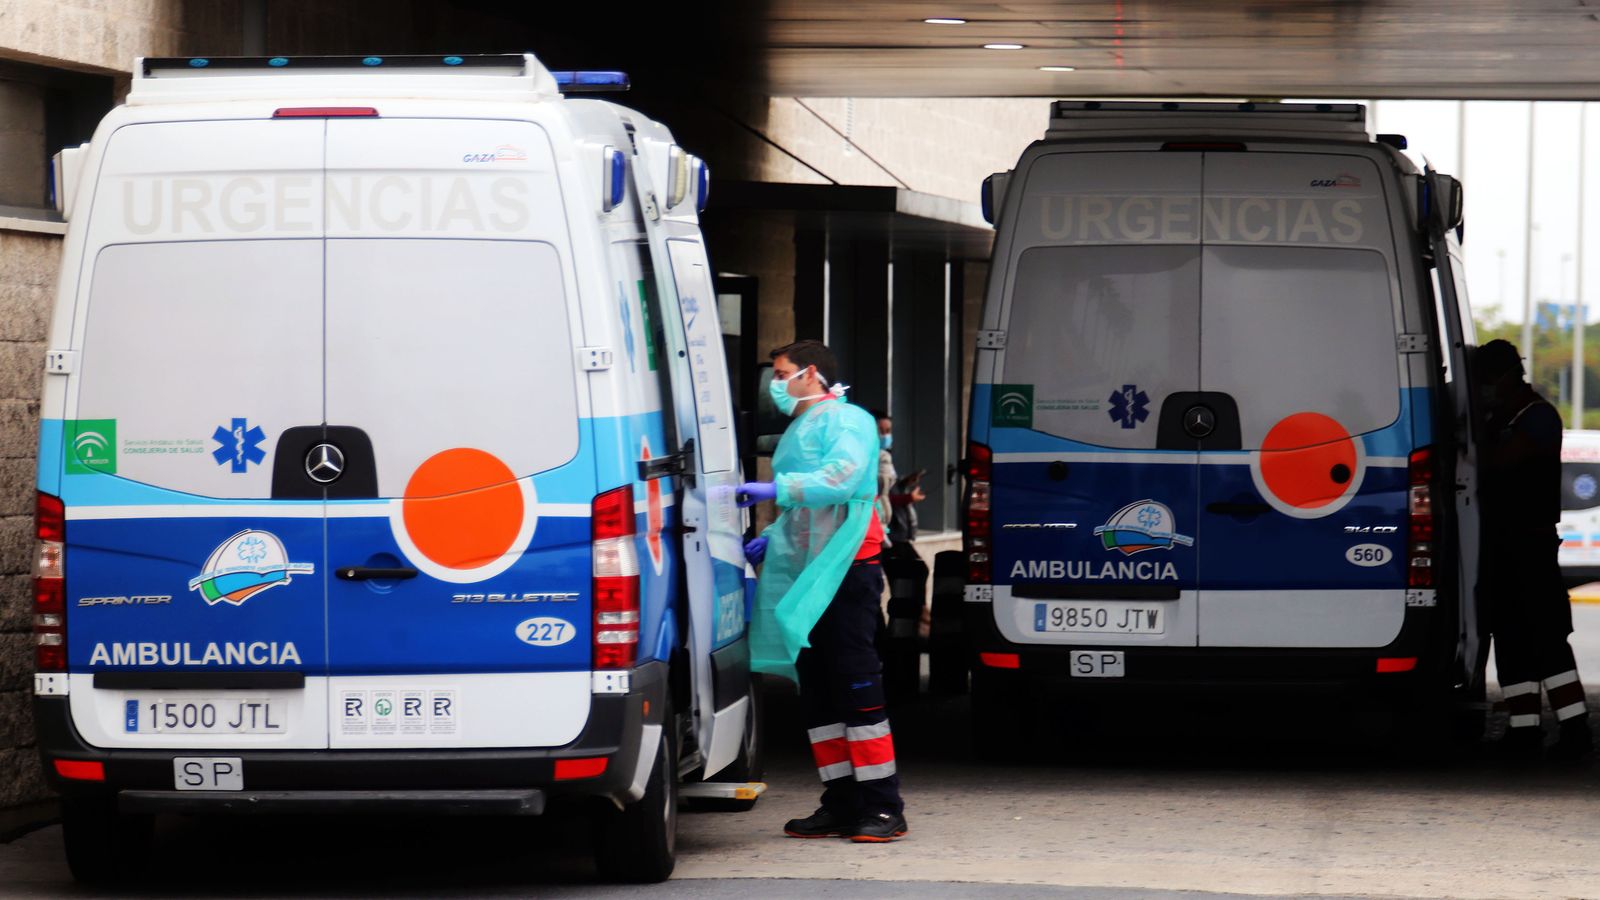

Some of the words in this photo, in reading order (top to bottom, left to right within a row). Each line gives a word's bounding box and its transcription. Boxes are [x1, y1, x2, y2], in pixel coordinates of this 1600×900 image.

[463, 153, 496, 163] GAZA
[1310, 179, 1337, 188] GAZA
[123, 175, 530, 235] URGENCIAS
[1040, 197, 1364, 242] URGENCIAS
[180, 446, 204, 454] SALUD
[1353, 548, 1384, 562] 560
[1009, 559, 1179, 581] AMBULANCIA
[77, 595, 172, 607] SPRINTER
[451, 594, 486, 603] 313
[487, 592, 580, 603] BLUETEC
[1051, 607, 1108, 628] 9850
[1117, 608, 1159, 629] JTW
[526, 623, 566, 641] 227
[89, 641, 302, 665] AMBULANCIA
[127, 718, 136, 727] E
[150, 703, 216, 729] 1500
[228, 703, 279, 729] JTL
